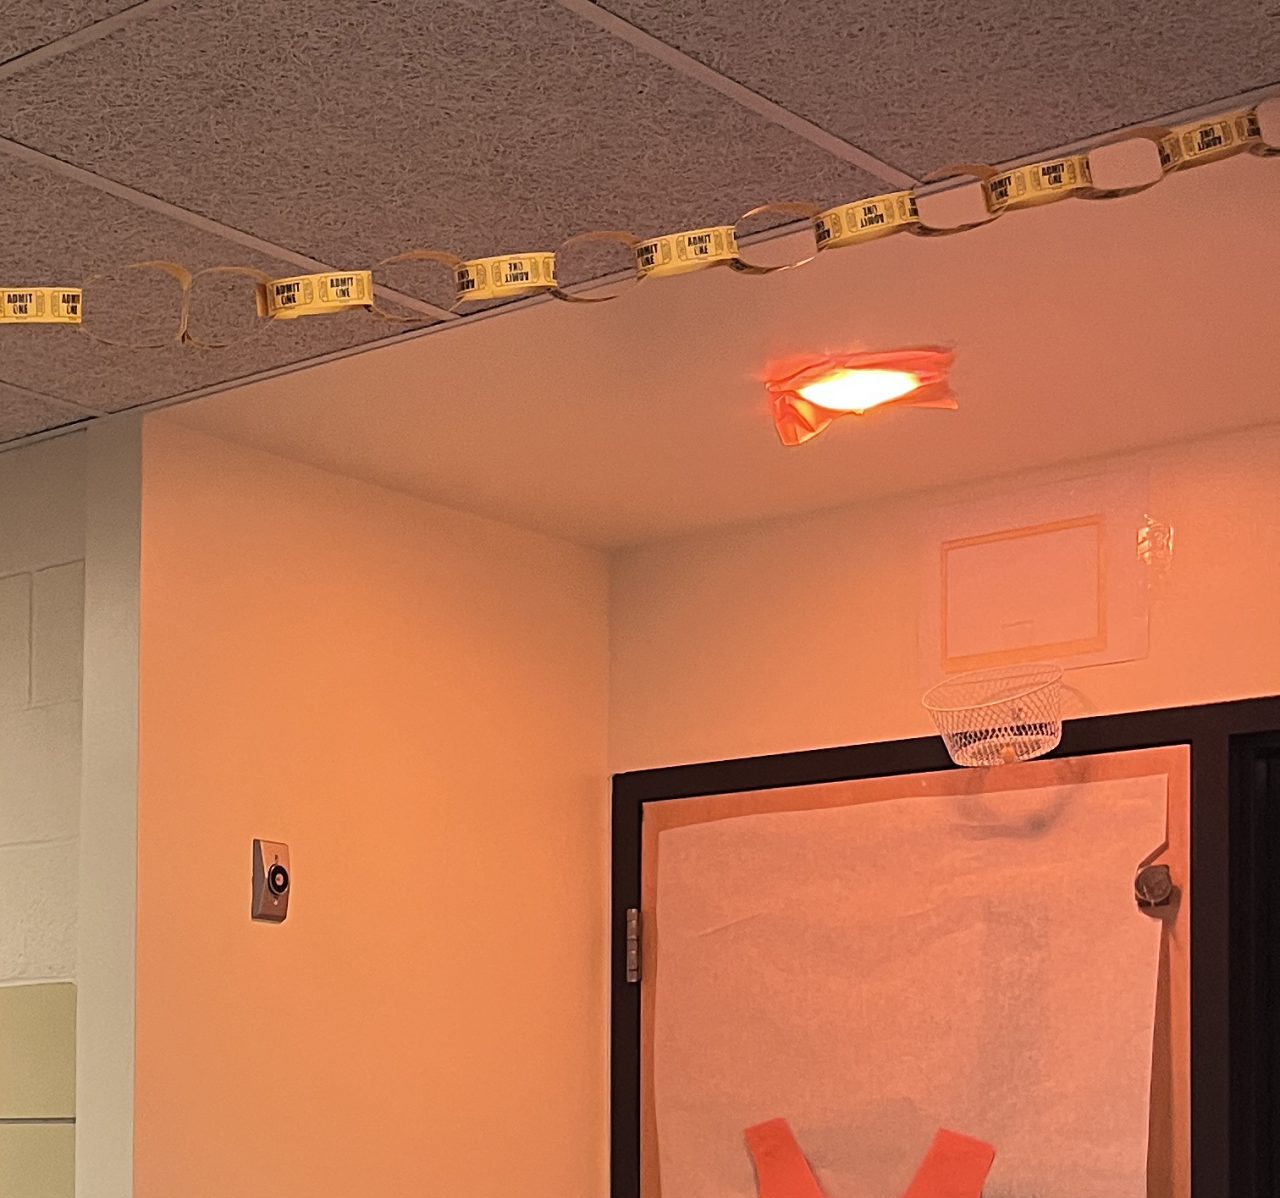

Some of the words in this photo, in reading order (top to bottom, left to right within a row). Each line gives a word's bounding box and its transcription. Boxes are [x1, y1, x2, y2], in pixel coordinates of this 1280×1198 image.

[688, 233, 711, 247] ADMIT
[329, 276, 354, 289] ADMIT
[275, 282, 301, 297] ADMIT
[335, 287, 351, 298] ONE
[7, 293, 33, 304] ADMIT
[281, 294, 297, 306] ONE
[12, 303, 28, 315] ONE
